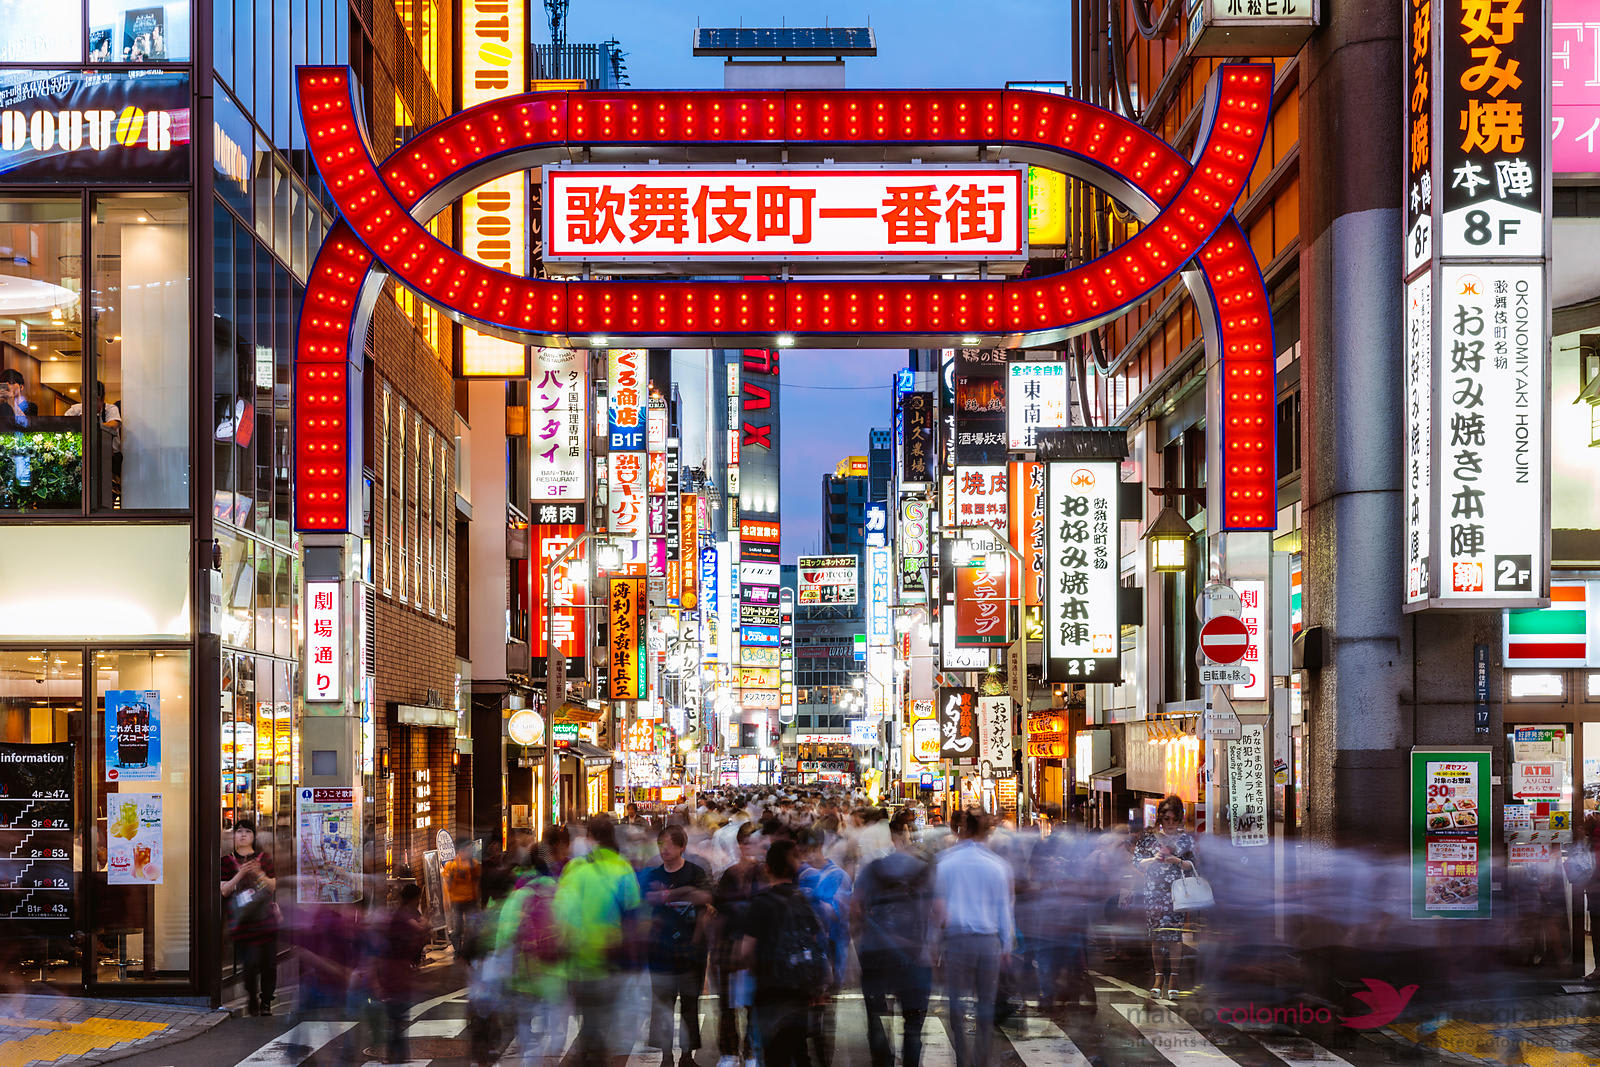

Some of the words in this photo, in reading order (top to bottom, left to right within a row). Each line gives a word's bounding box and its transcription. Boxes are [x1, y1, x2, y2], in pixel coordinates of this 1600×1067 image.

[1411, 0, 1431, 173] 好み焼
[1459, 0, 1525, 154] 好み焼
[1, 106, 171, 151] DOUTOR
[1452, 158, 1533, 198] 本陣
[566, 184, 1005, 244] 歌舞伎町一番街
[1464, 210, 1521, 246] 8F
[1414, 225, 1429, 259] 8F
[1493, 280, 1508, 370] 歌舞伎町名物
[1515, 280, 1529, 408] OKONOMIYAKI
[616, 349, 638, 426] ぐろ商店
[1011, 365, 1063, 376] 全卓全自動
[537, 370, 564, 463] バンタイ
[568, 370, 579, 457] タイ国料理専門店
[1450, 304, 1486, 558] お好み焼き本陣
[612, 434, 643, 447] B1F
[1515, 413, 1529, 484] HONJIN
[547, 486, 567, 496] 3F
[540, 506, 577, 523] 焼肉
[1059, 494, 1090, 647] お好み焼本陣
[1497, 560, 1530, 585] 2F
[313, 591, 333, 691] 劇場通り
[1068, 659, 1095, 676] 2F
[1203, 669, 1248, 682] 自転車を除く
[110, 725, 157, 733] これが、日本の
[990, 702, 1010, 760] お好み焼き
[1477, 712, 1488, 721] 17
[110, 734, 157, 742] アイスコーヒー
[1, 753, 64, 763] information
[1524, 766, 1551, 776] ATM
[32, 790, 43, 798] 4F
[1252, 729, 1265, 831] みなさまの安全を守ります
[31, 849, 42, 857] 2F
[34, 879, 42, 887] 1F
